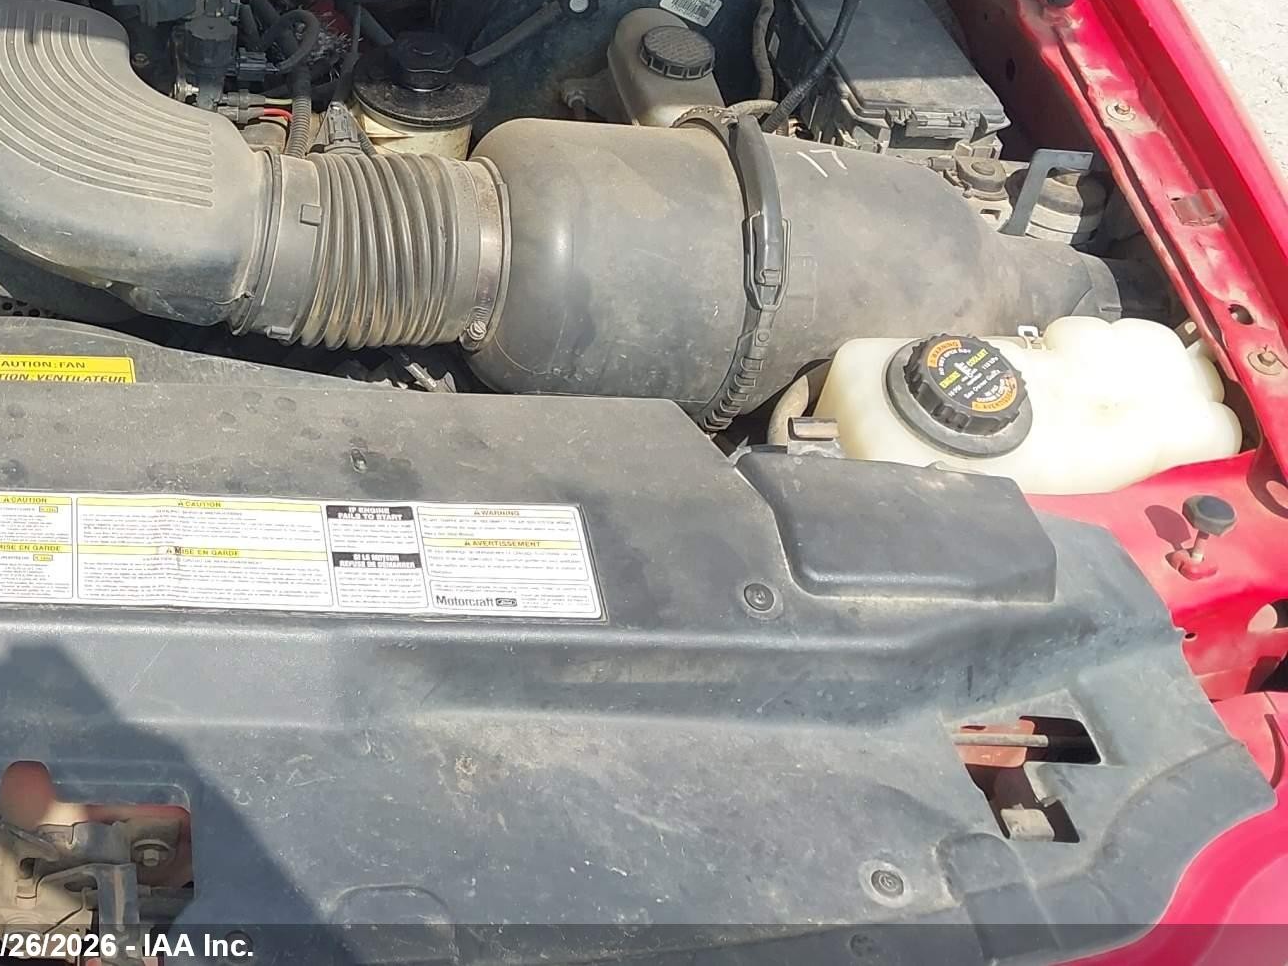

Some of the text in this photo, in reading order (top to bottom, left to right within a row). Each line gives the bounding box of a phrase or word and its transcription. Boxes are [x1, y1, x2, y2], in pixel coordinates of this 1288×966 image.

[60, 361, 86, 369] FAN
[37, 374, 127, 383] VENTILATEUR
[175, 547, 194, 555] MISE
[436, 595, 494, 607] Motorcraft
